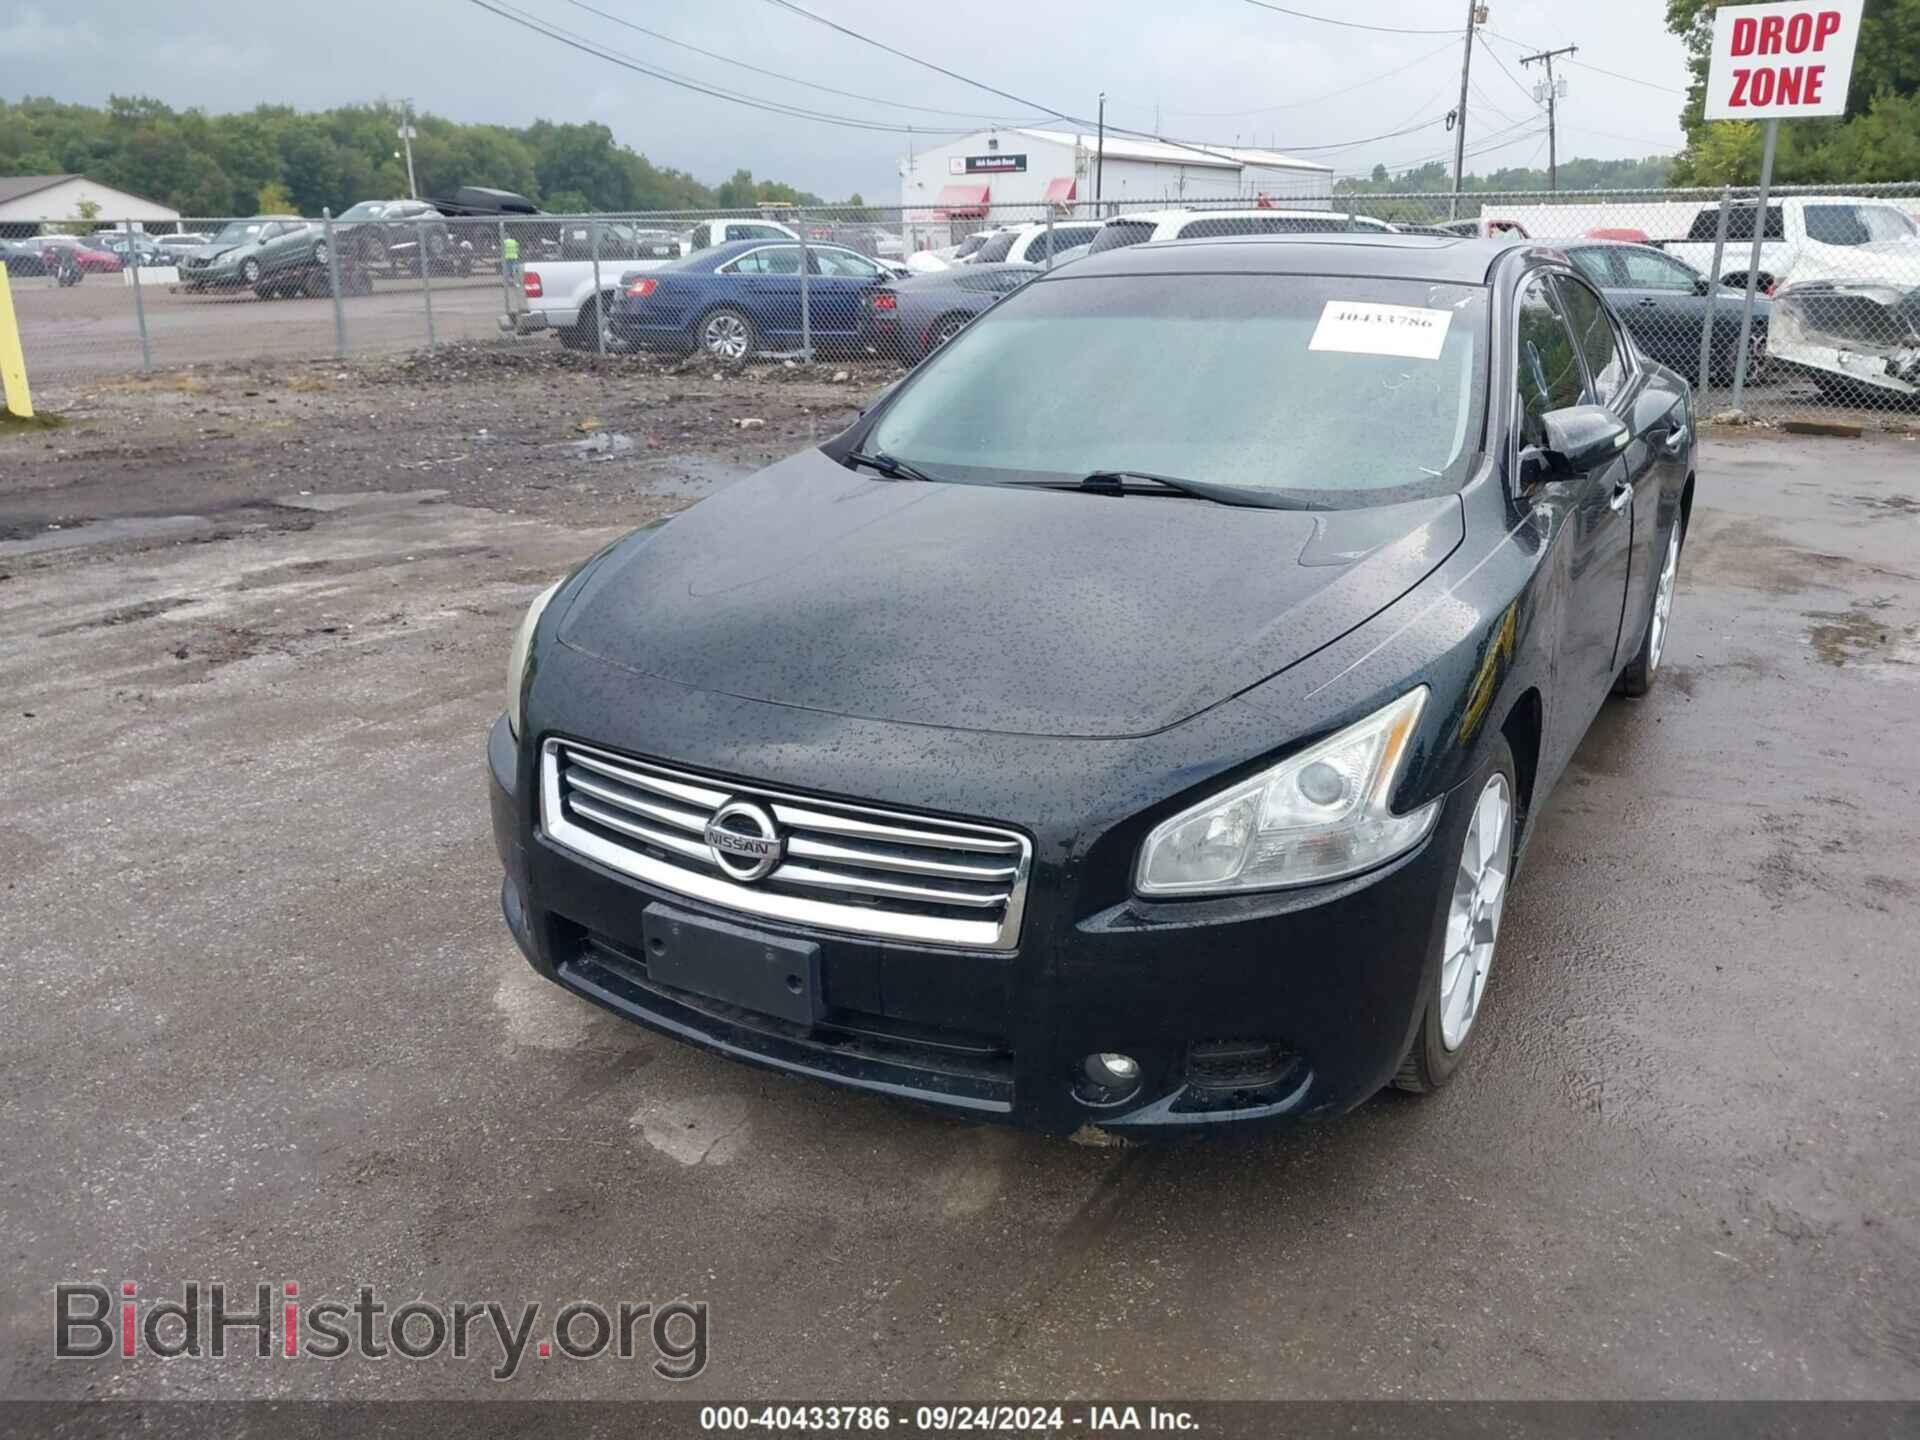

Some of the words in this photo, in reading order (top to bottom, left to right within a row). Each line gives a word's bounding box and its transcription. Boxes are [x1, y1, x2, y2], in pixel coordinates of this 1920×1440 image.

[1730, 11, 1841, 57] DROP
[1728, 65, 1826, 107] ZONE
[1335, 311, 1433, 329] 40433786
[709, 831, 768, 855] NISSAN
